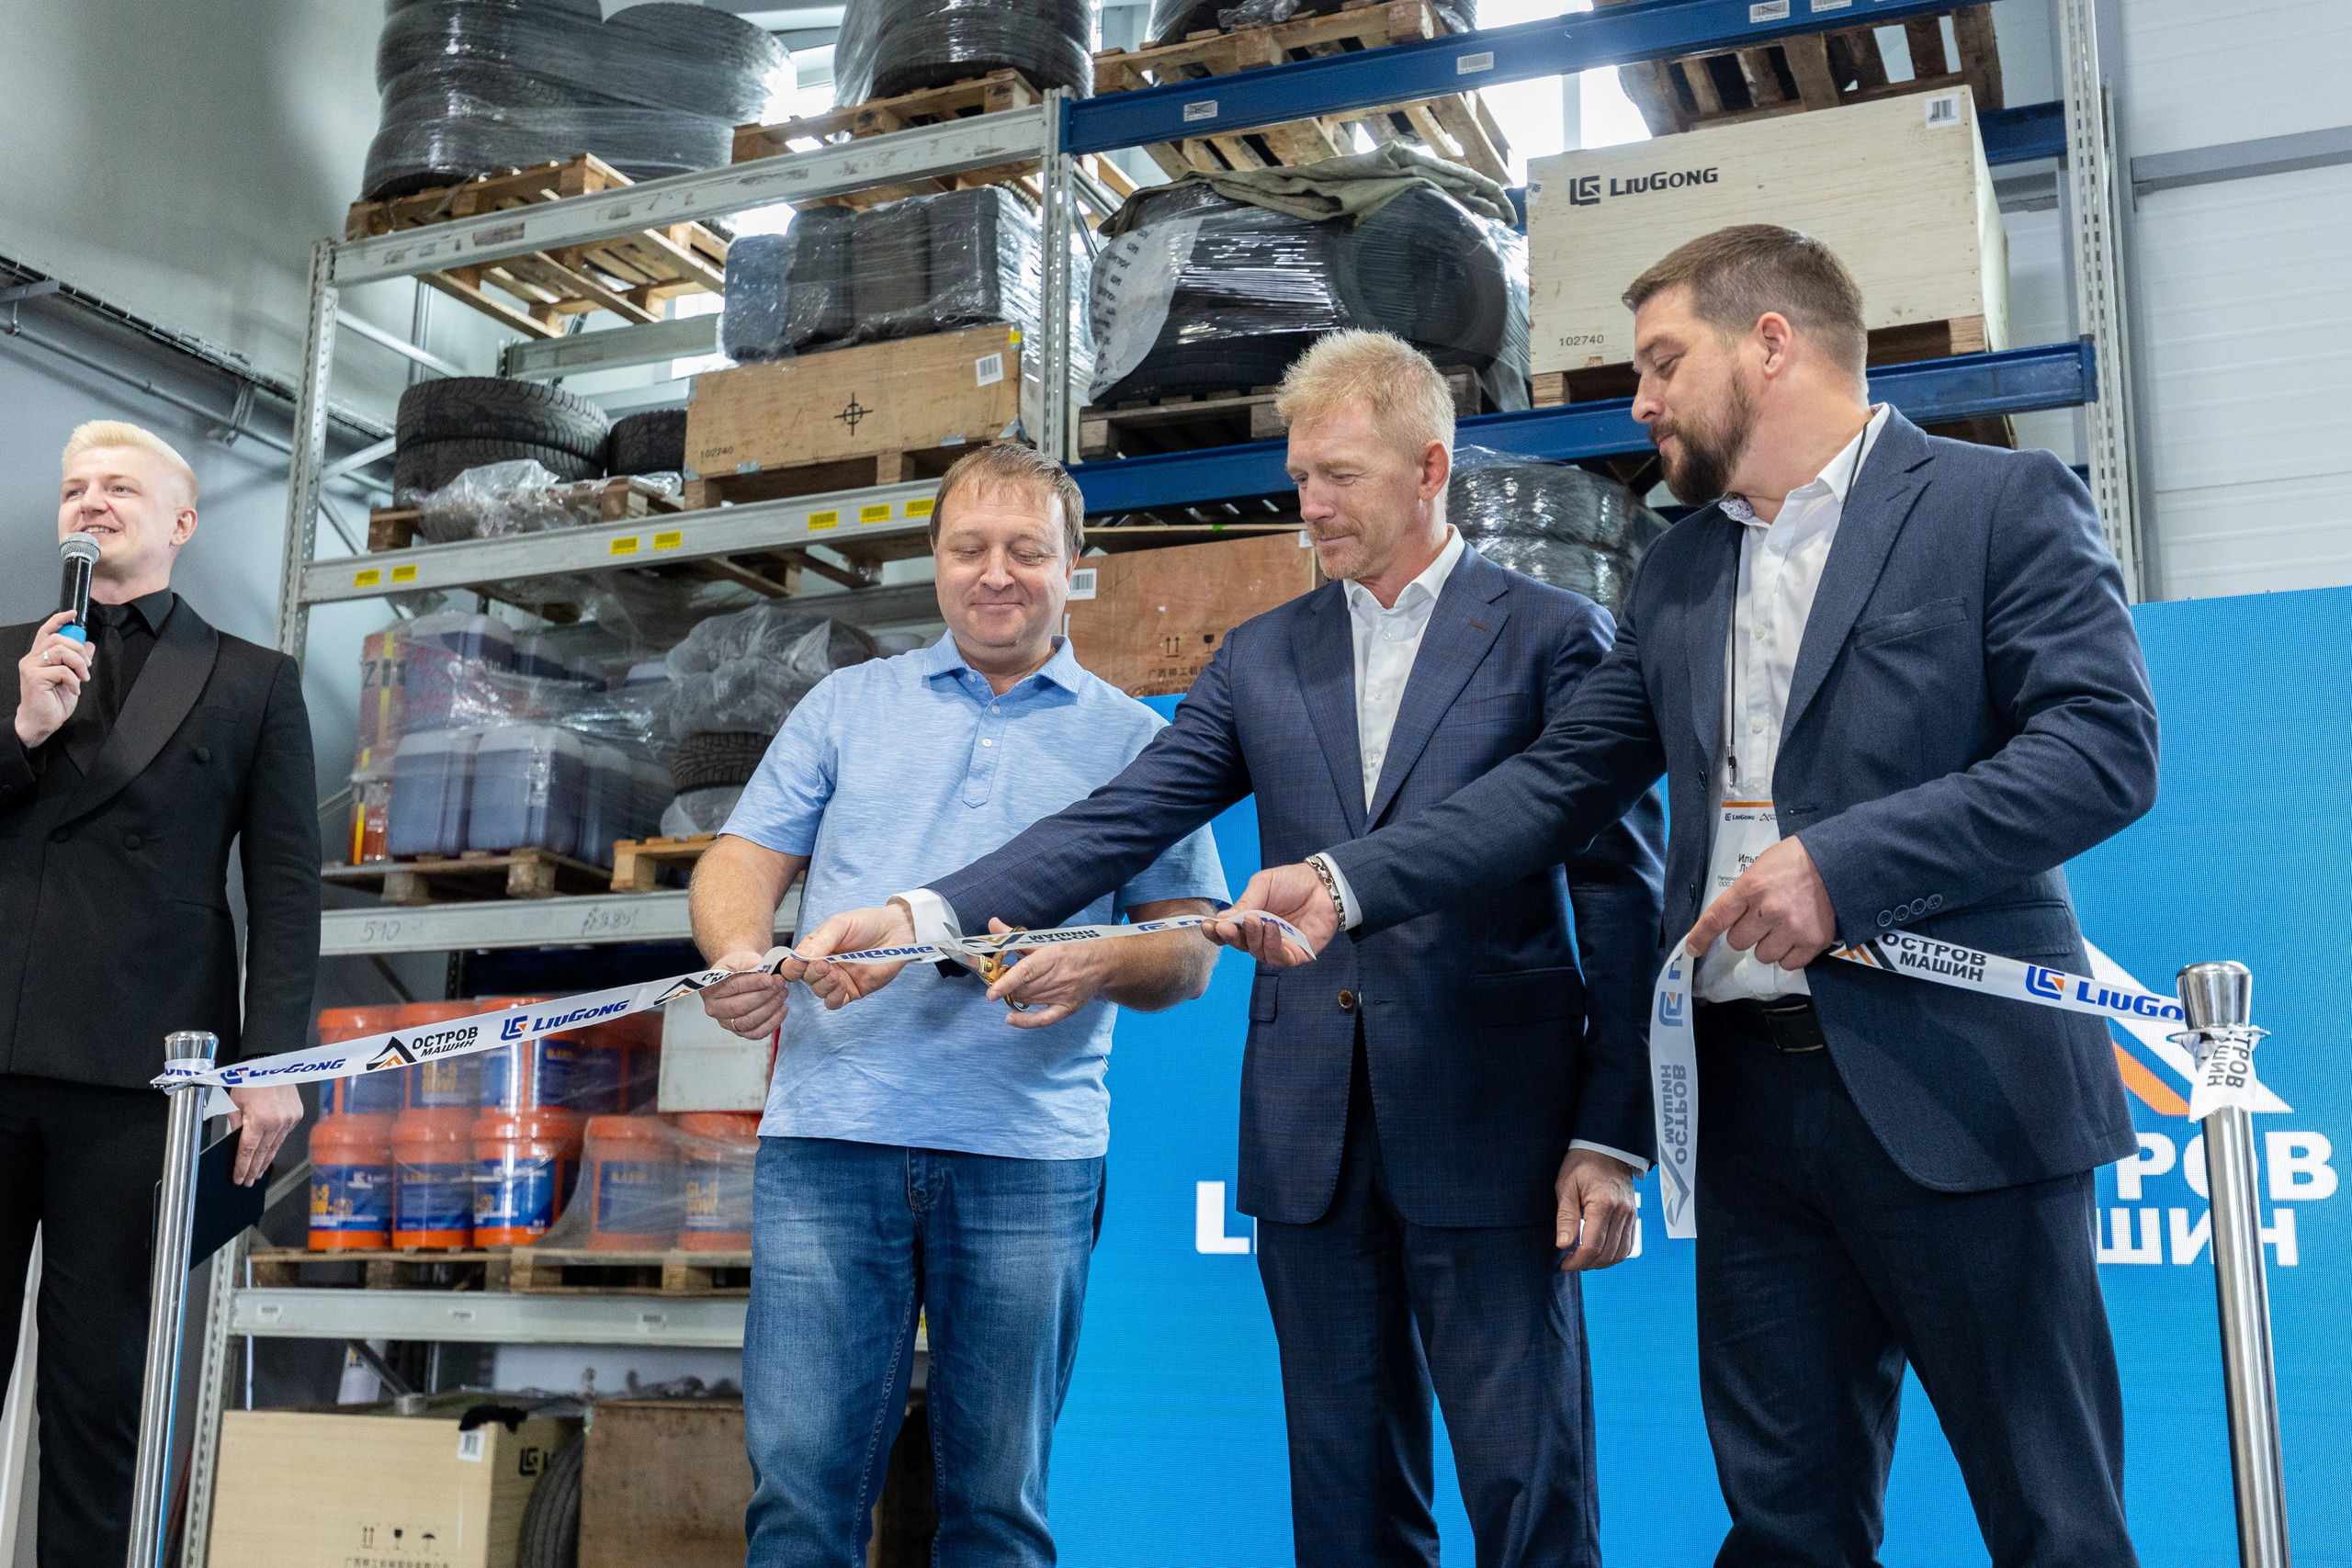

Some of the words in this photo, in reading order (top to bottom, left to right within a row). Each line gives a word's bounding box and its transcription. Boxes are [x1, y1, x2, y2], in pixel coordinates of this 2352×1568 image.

[1559, 333, 1604, 346] 102740
[700, 446, 734, 461] 102740
[1882, 932, 1987, 967] ОСТРОВ
[1898, 951, 1985, 983] МАШИН
[412, 1026, 479, 1050] ОСТРОВ
[420, 1039, 475, 1057] МАШИН
[2207, 1036, 2233, 1088] ШИН
[2224, 1032, 2253, 1089] ТРОВ
[2096, 1208, 2298, 1267] ШИН
